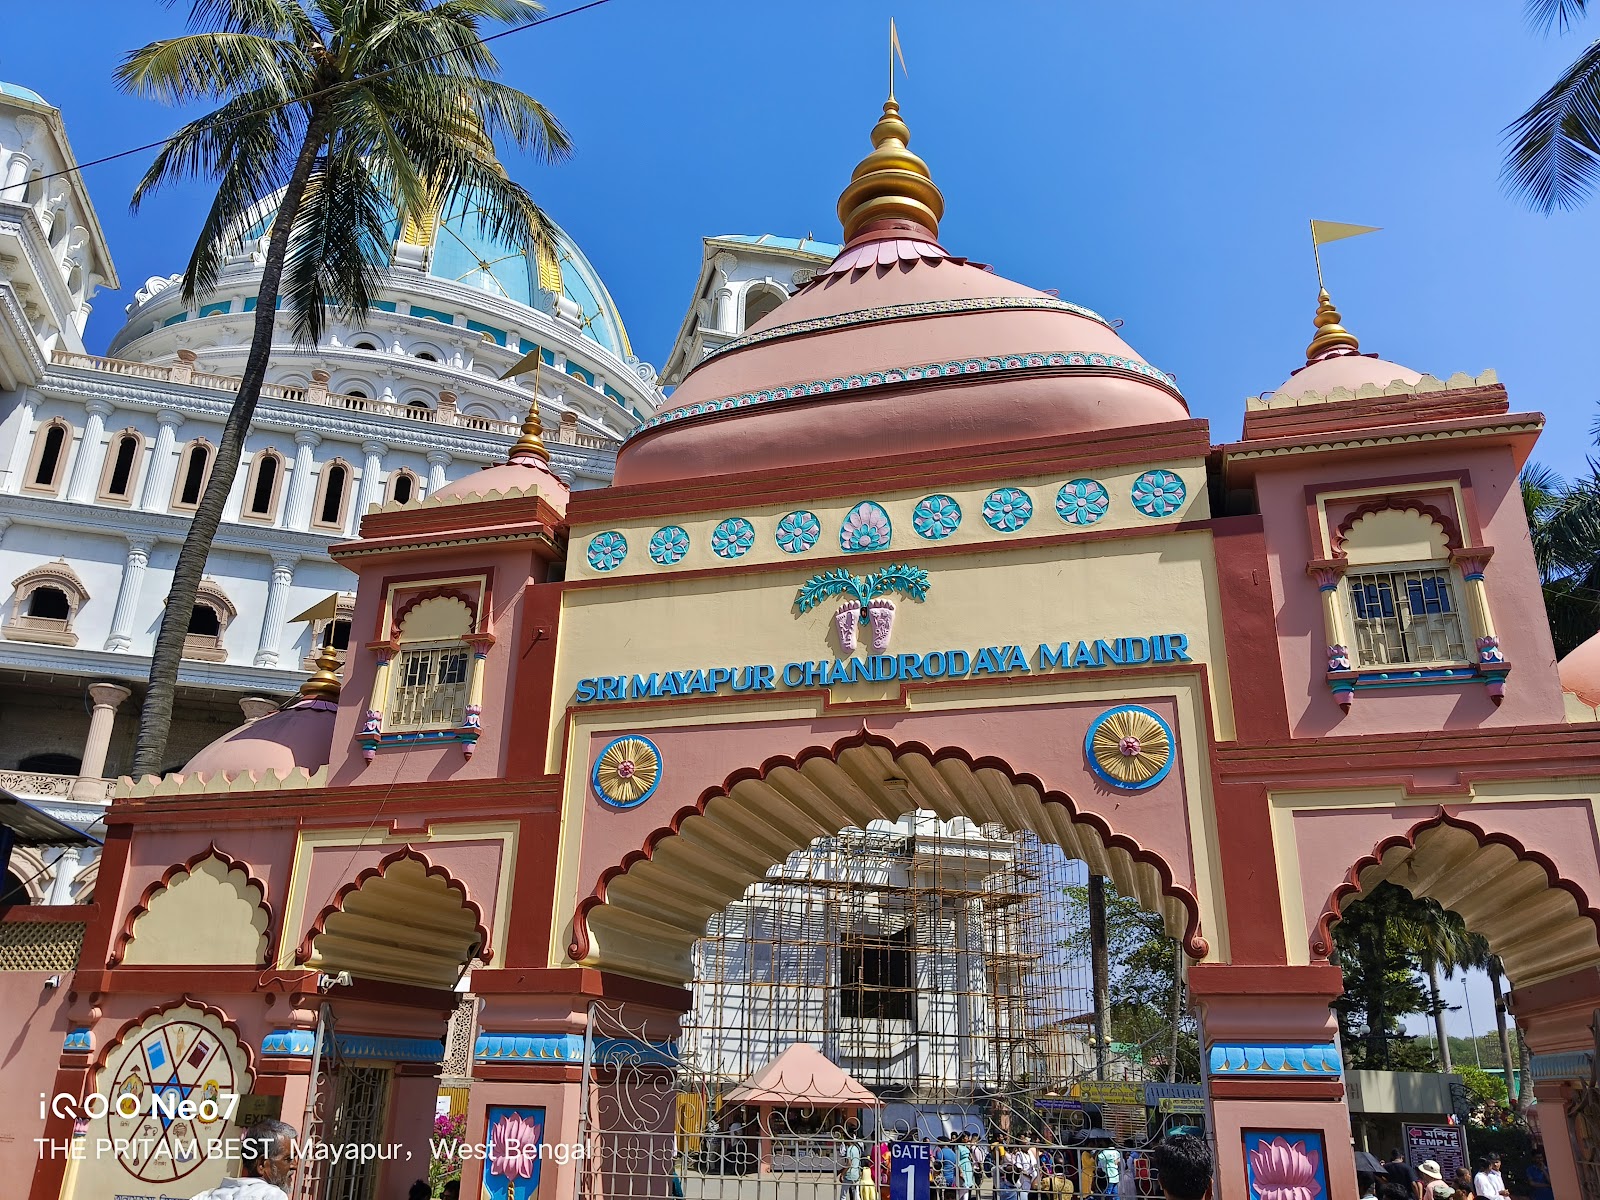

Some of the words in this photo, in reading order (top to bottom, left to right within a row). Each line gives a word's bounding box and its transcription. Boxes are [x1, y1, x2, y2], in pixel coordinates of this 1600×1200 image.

[576, 675, 627, 703] SRI
[631, 664, 776, 699] MAYAPUR
[782, 645, 1031, 687] CHANDRODAYA
[1039, 633, 1194, 670] MANDIR
[1410, 1137, 1459, 1147] TEMPLE
[1423, 1128, 1458, 1140] মন্দির
[892, 1144, 929, 1160] GATE
[900, 1164, 915, 1200] 1
